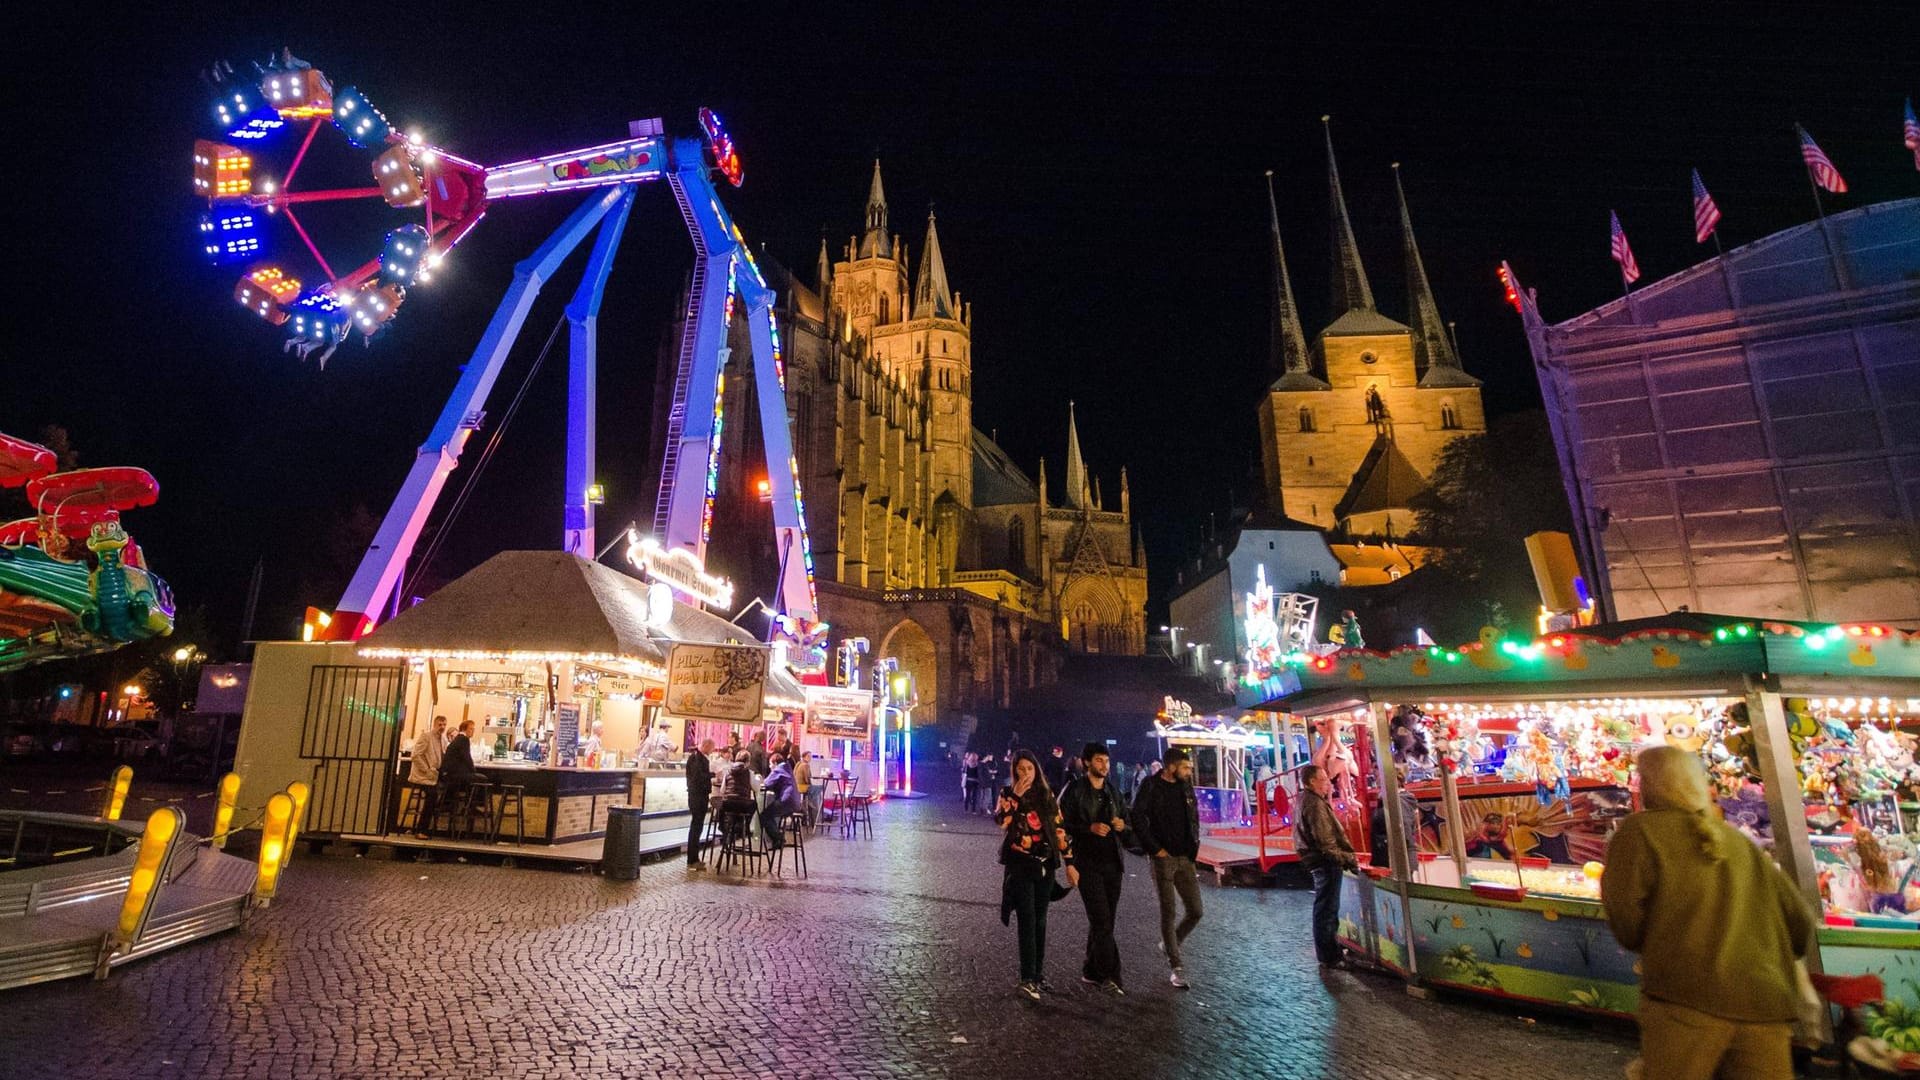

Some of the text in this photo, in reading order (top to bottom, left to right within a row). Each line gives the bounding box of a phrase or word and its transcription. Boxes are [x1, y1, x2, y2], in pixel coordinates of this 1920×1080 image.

[652, 555, 689, 585] Gourmet
[675, 654, 709, 669] PILZ-
[610, 680, 631, 690] Bier
[673, 670, 723, 685] PFANNE
